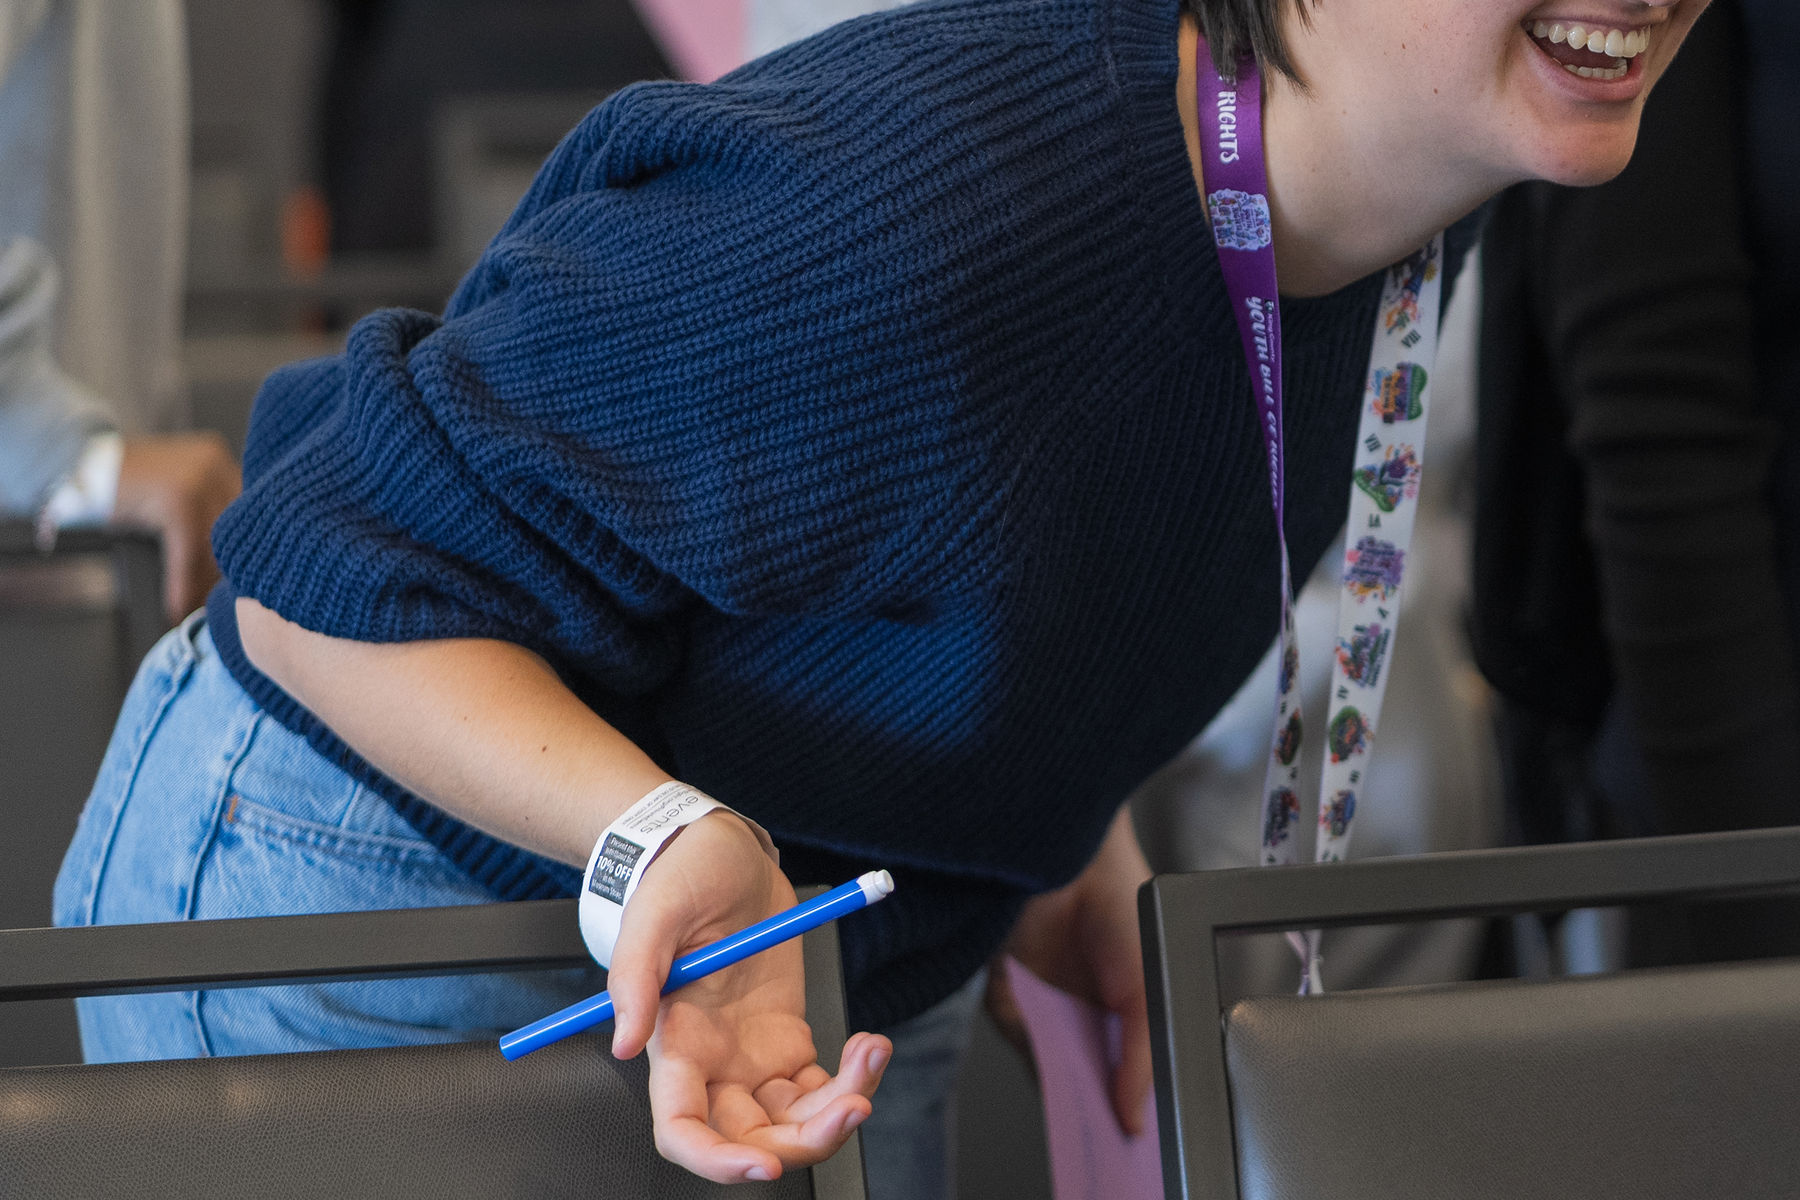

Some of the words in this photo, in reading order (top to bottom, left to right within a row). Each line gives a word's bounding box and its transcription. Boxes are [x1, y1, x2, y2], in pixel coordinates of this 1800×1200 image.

[1217, 91, 1239, 164] RIGHTS
[1245, 296, 1268, 360] YOUTH
[1401, 329, 1421, 348] VIII
[1364, 433, 1382, 452] VII
[641, 795, 699, 834] events
[597, 855, 615, 874] 10%
[614, 863, 633, 881] OFF
